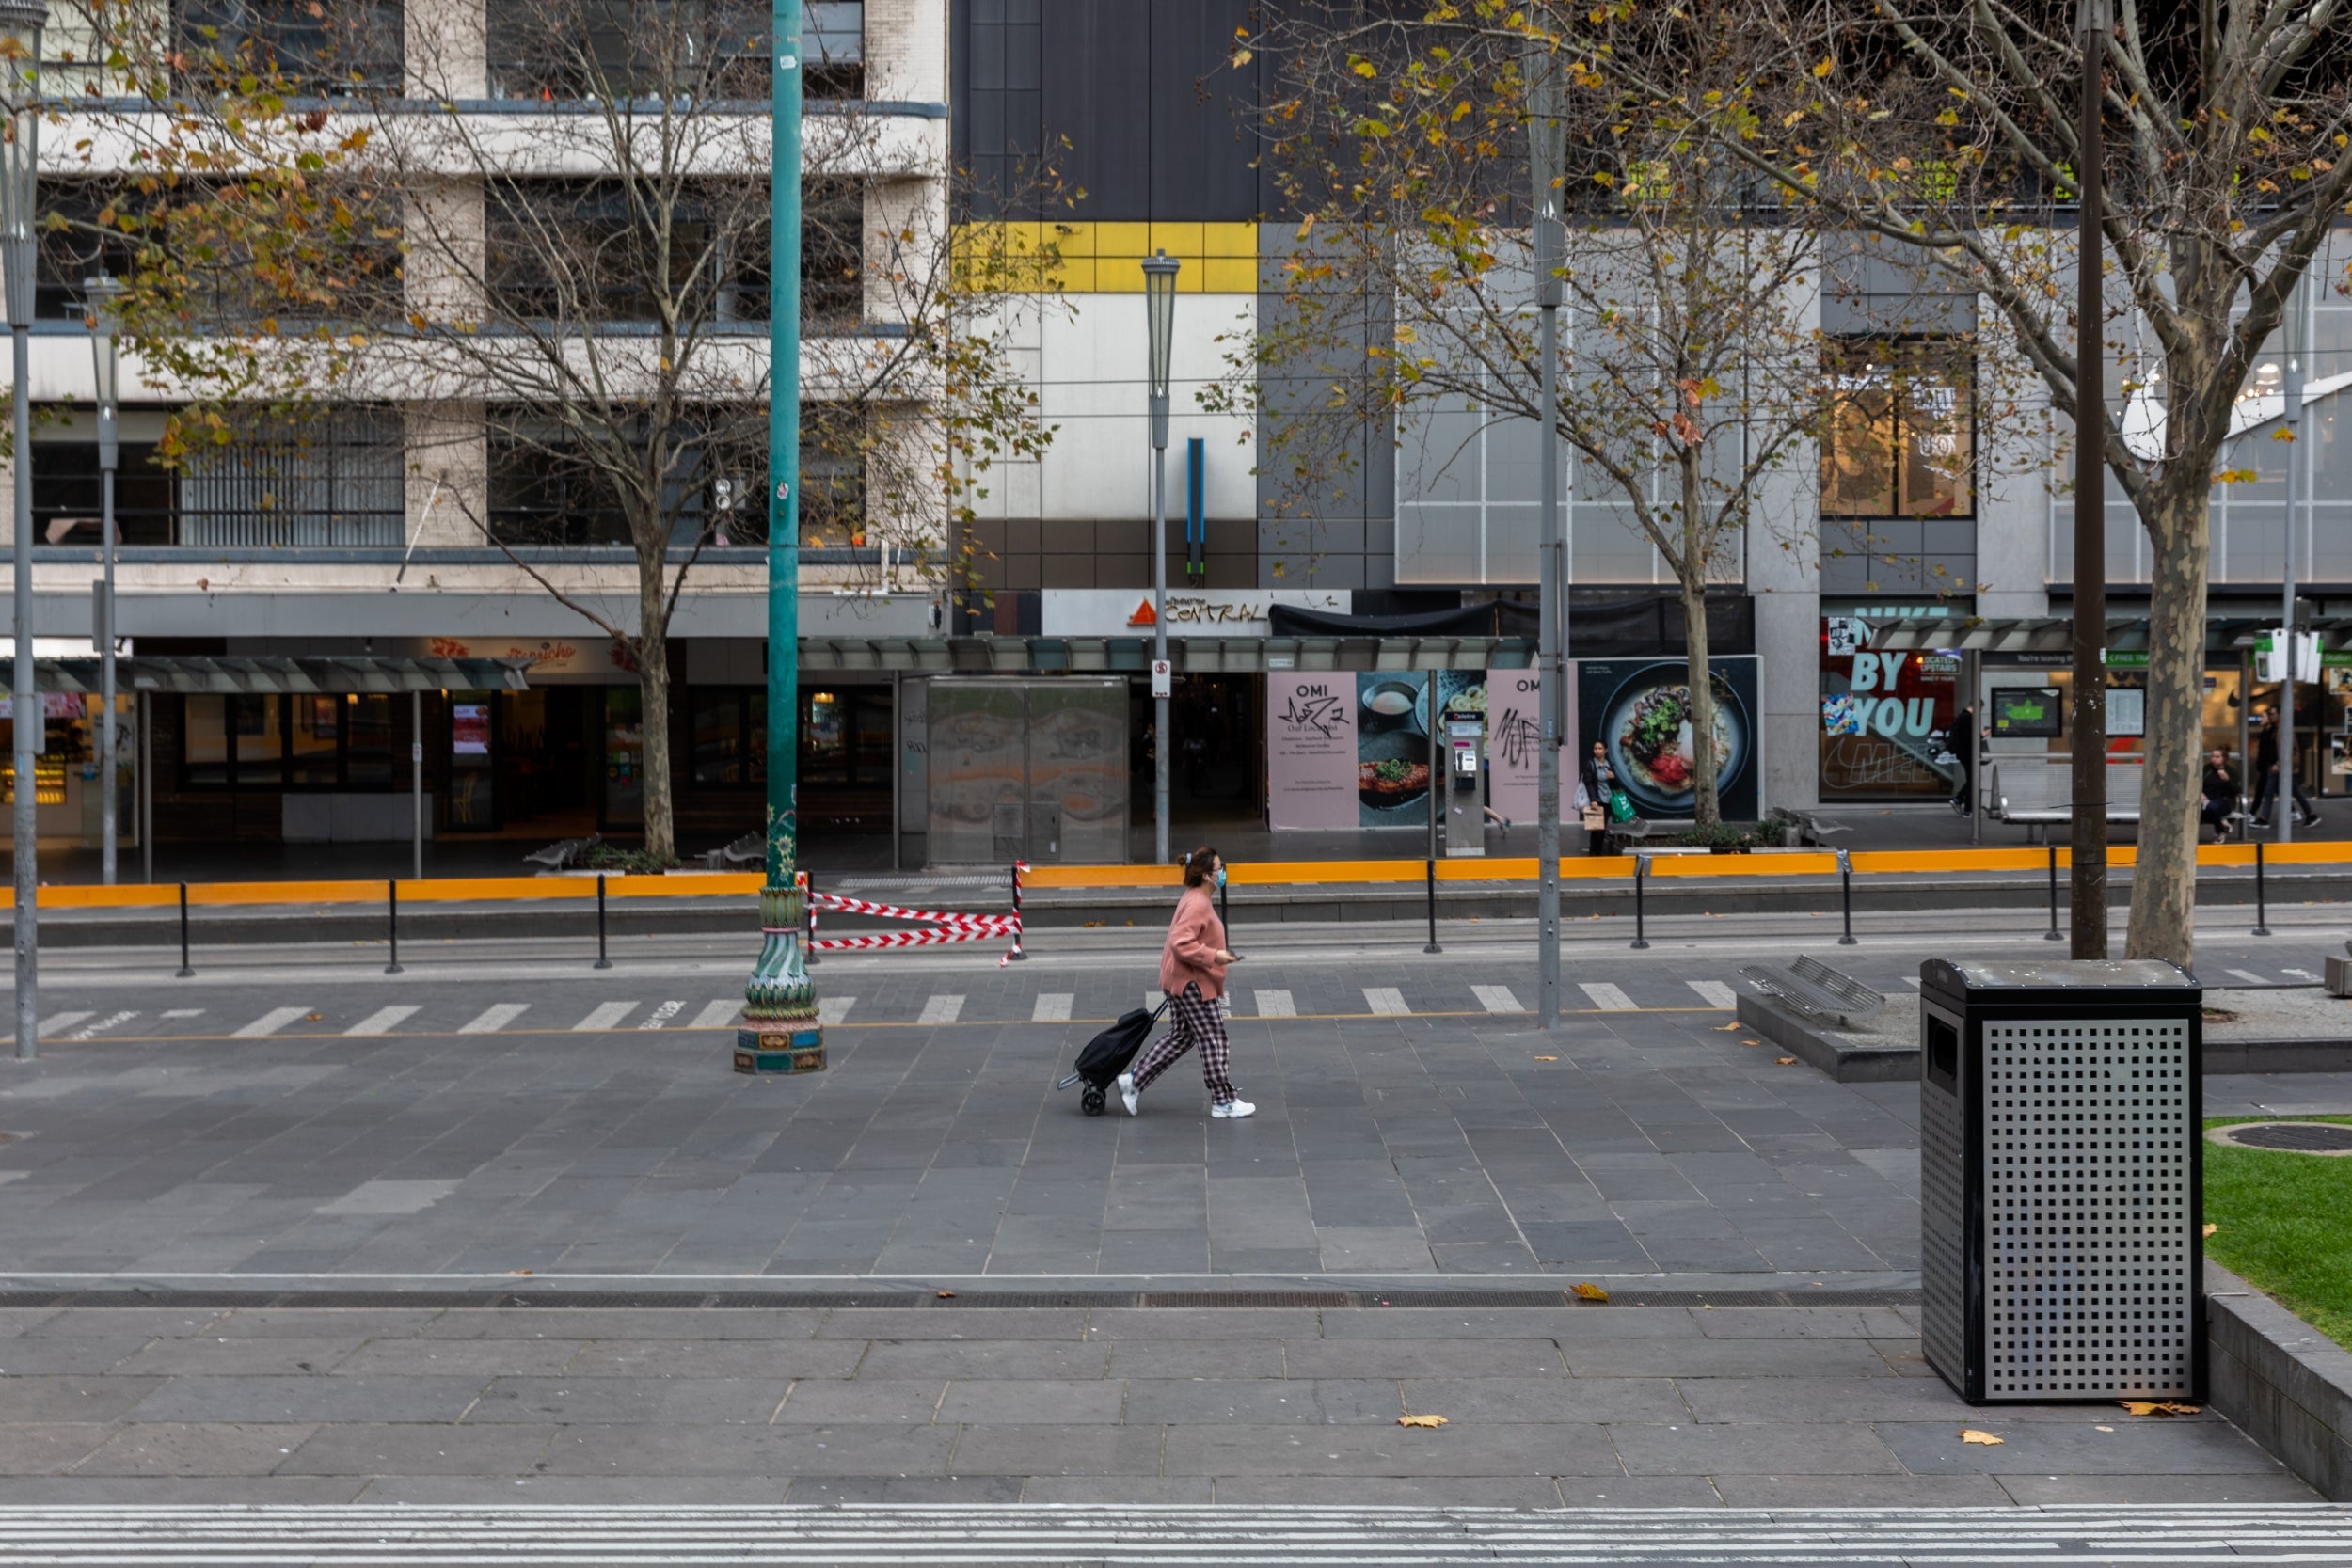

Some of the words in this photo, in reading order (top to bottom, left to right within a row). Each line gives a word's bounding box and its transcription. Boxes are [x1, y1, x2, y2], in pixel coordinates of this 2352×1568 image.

[1851, 652, 1908, 691] BY
[2040, 654, 2065, 664] leaving
[1296, 685, 1327, 697] OMI
[1852, 697, 1935, 736] YOU
